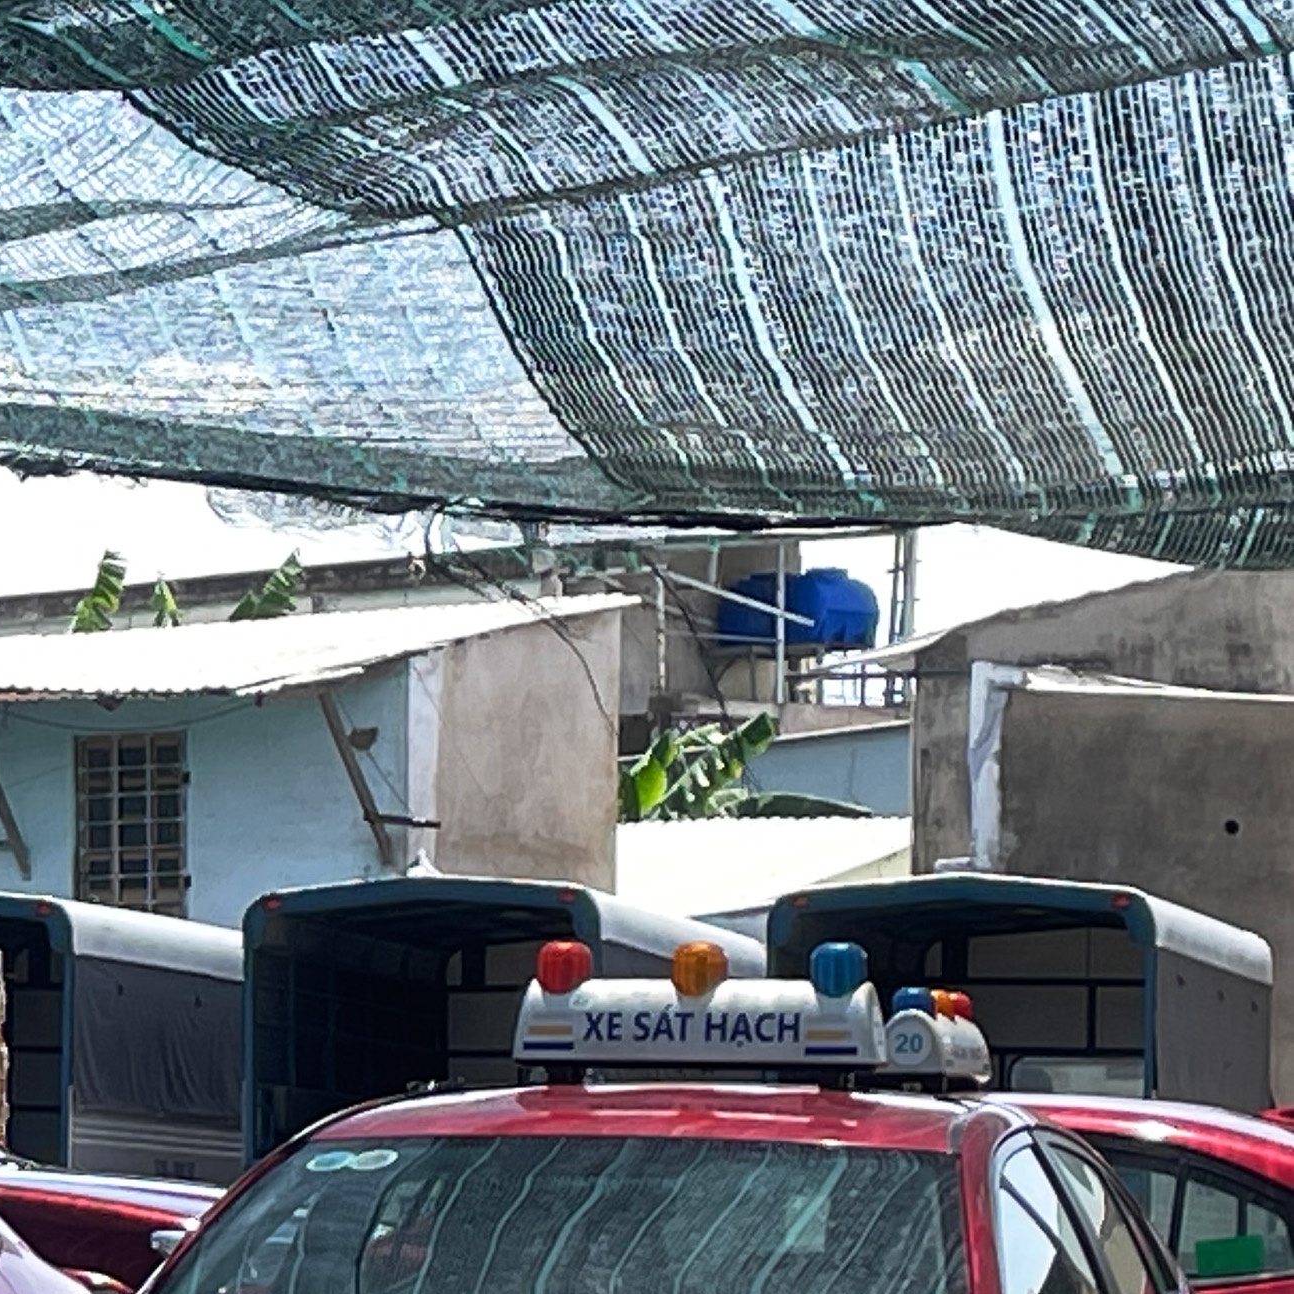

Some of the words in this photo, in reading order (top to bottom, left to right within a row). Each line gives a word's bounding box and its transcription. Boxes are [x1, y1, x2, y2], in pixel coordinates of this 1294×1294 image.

[582, 1011, 622, 1043] XE
[633, 1004, 694, 1042] SÁT
[705, 1012, 801, 1048] HẠCH
[894, 1033, 924, 1054] 20
